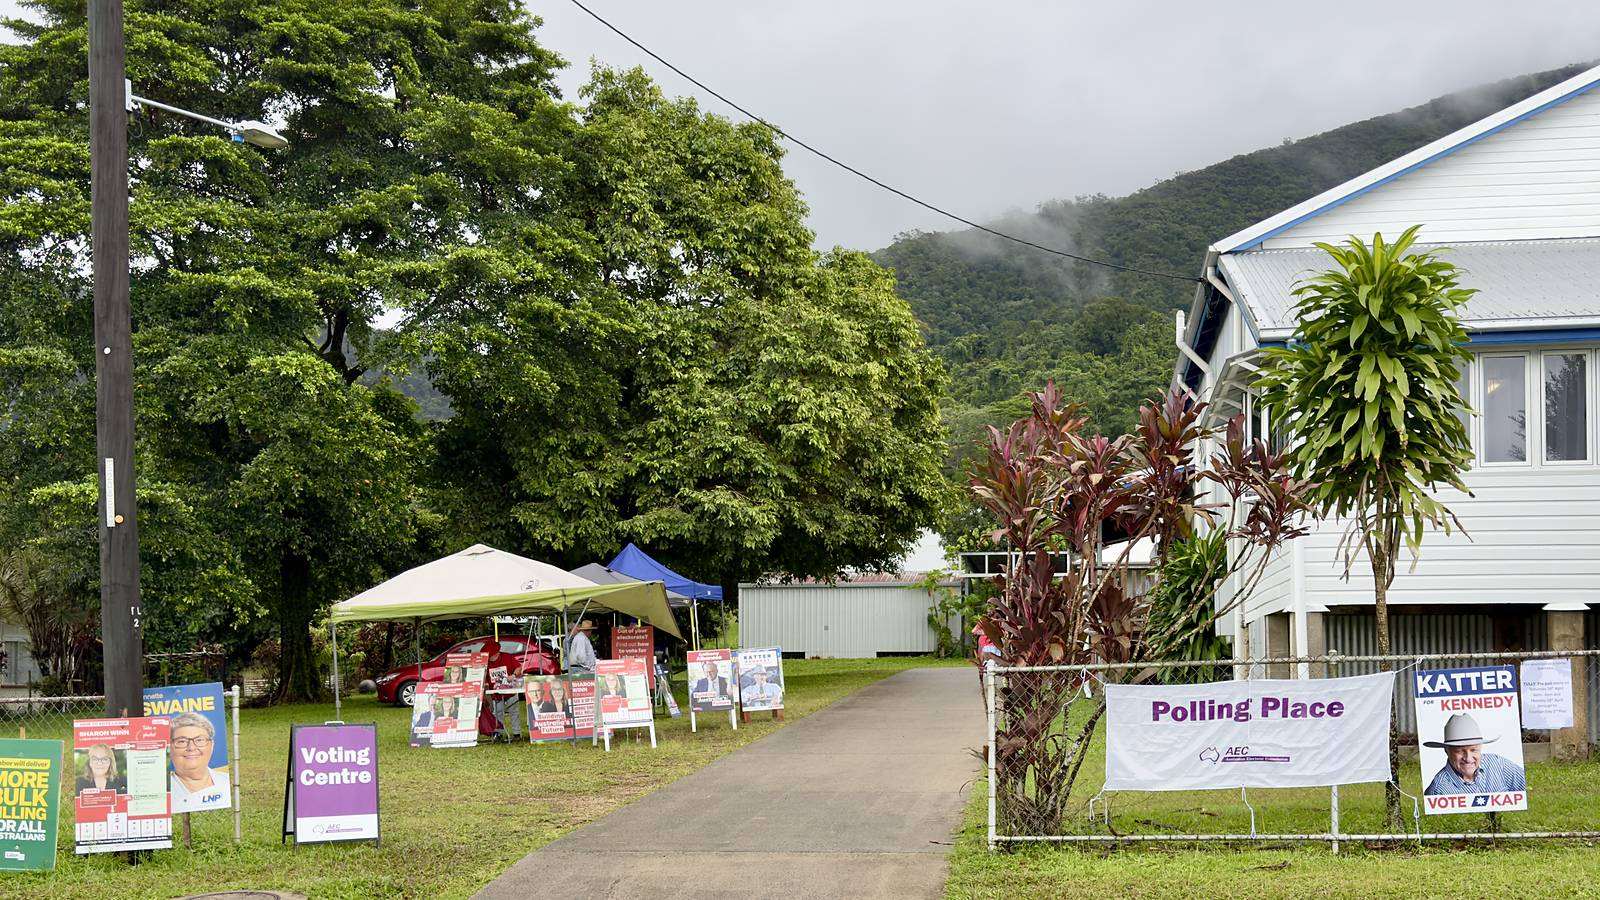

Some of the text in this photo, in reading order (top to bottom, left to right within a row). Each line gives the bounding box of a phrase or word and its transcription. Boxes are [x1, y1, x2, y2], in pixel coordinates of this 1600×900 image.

[133, 618, 139, 627] 2
[1417, 670, 1514, 694] KATTER
[143, 696, 215, 717] SWAINE
[1152, 697, 1345, 722] Polling Place
[1440, 695, 1514, 711] KENNEDY
[300, 746, 371, 766] Voting
[1225, 746, 1249, 755] AEC
[300, 767, 372, 786] Centre
[0, 788, 48, 807] ULK
[202, 794, 221, 803] LNP
[1427, 793, 1524, 809] VOTE KAP
[18, 820, 46, 833] ALL
